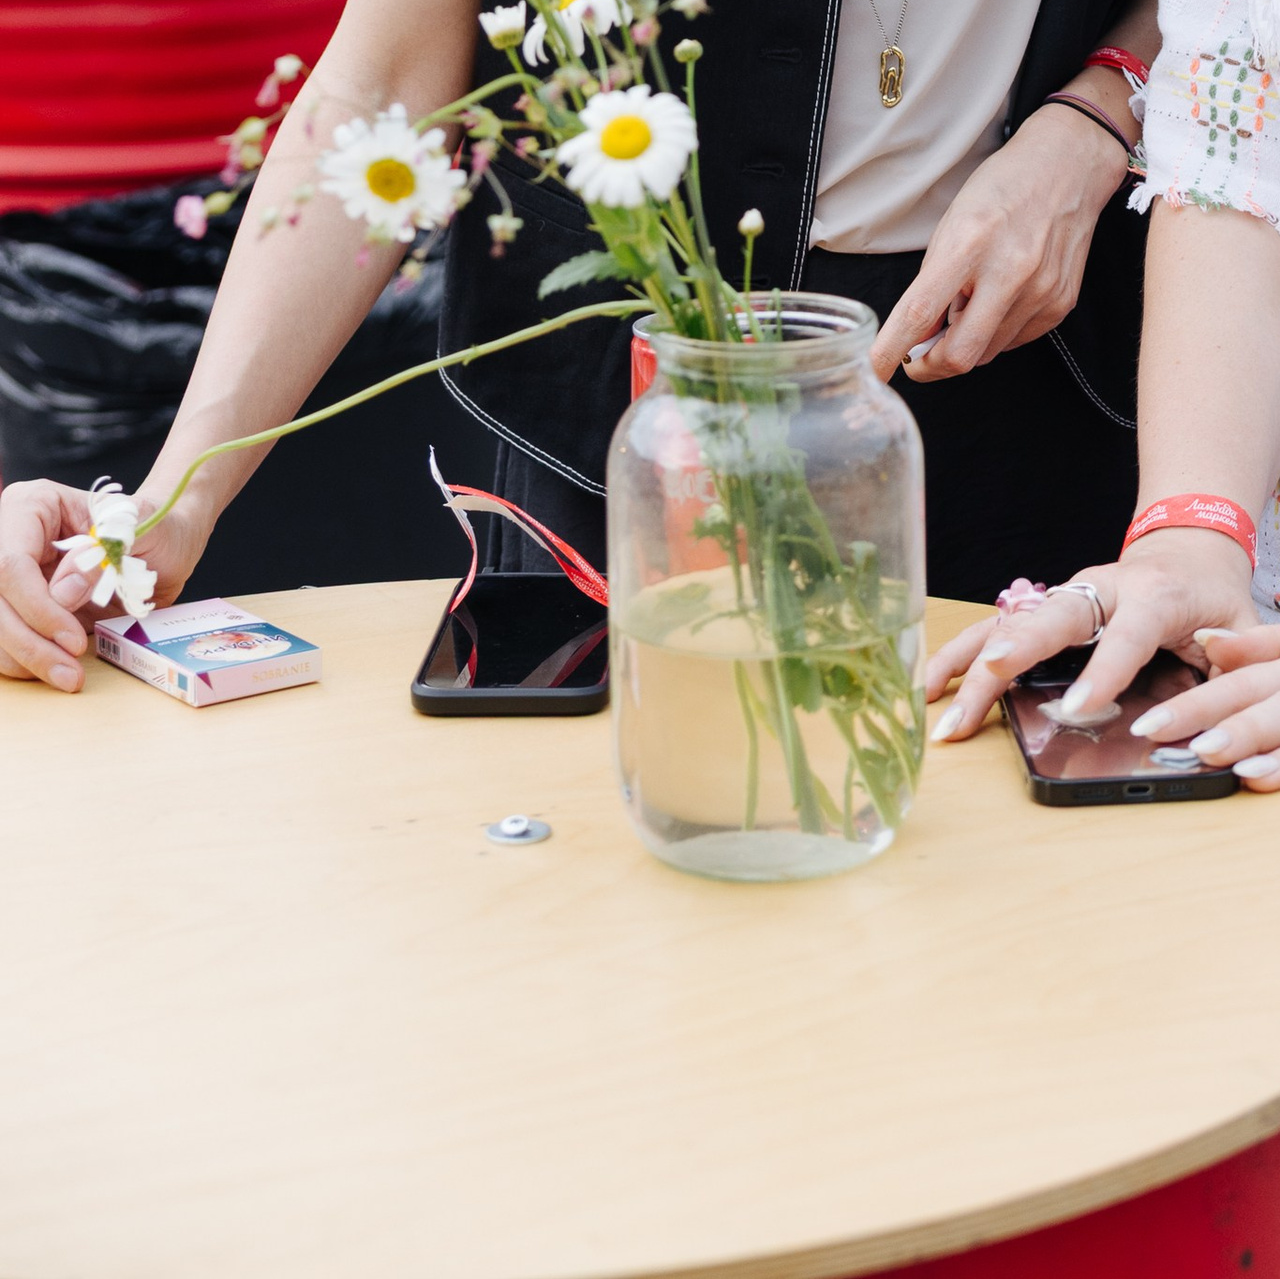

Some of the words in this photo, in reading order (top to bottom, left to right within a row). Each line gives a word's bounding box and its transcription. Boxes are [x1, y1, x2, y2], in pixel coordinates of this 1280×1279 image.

[1184, 497, 1239, 520] Ламбада
[1195, 510, 1239, 530] маркет
[187, 634, 289, 659] ИНФАРКТ
[252, 661, 311, 683] SOBRANIE
